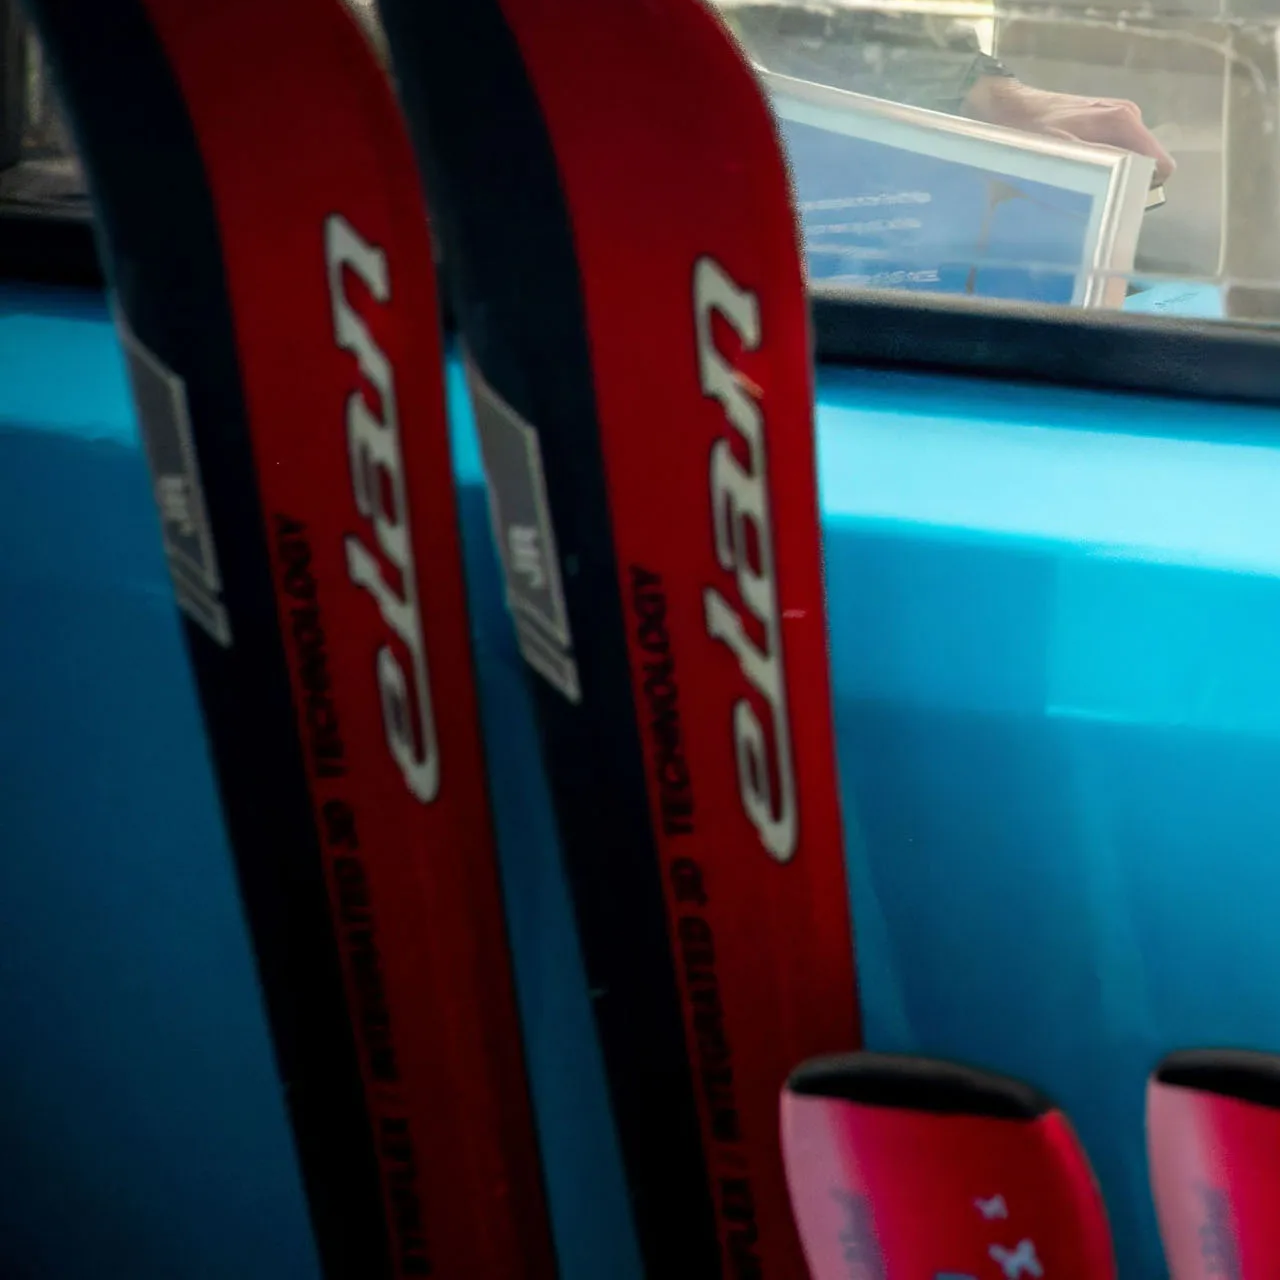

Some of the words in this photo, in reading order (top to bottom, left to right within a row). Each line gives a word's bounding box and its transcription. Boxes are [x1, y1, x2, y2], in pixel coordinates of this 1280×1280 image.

[325, 212, 441, 805] elan
[508, 523, 547, 588] JR
[692, 255, 801, 864] elan
[276, 518, 346, 776] TECHNOLOGY
[631, 567, 692, 833] TECHNOLOGY
